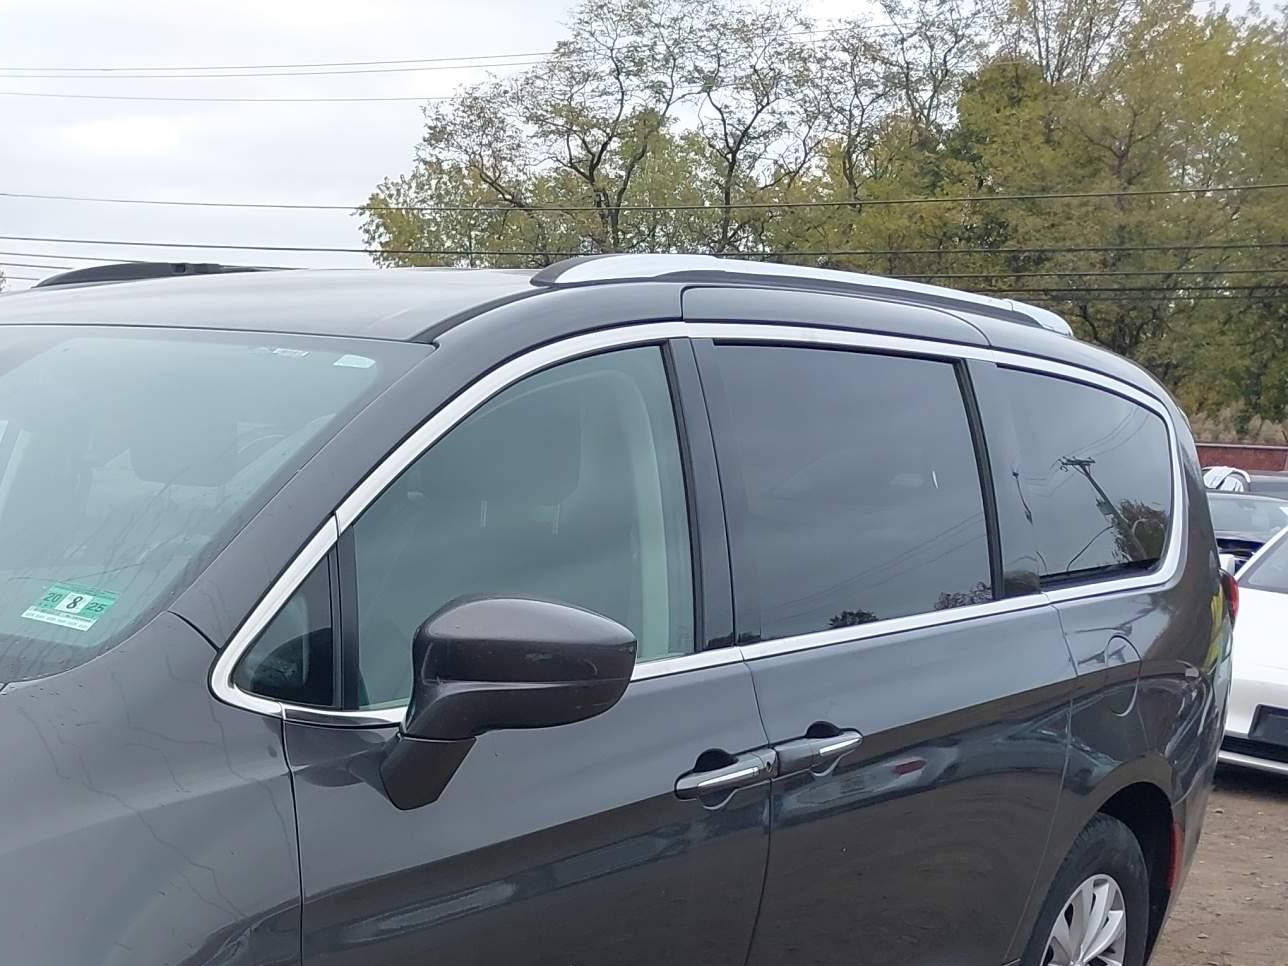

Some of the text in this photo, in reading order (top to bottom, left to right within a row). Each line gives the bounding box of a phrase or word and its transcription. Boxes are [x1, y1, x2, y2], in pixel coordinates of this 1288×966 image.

[43, 592, 63, 603] 20
[65, 596, 84, 609] 8
[86, 602, 108, 613] 25
